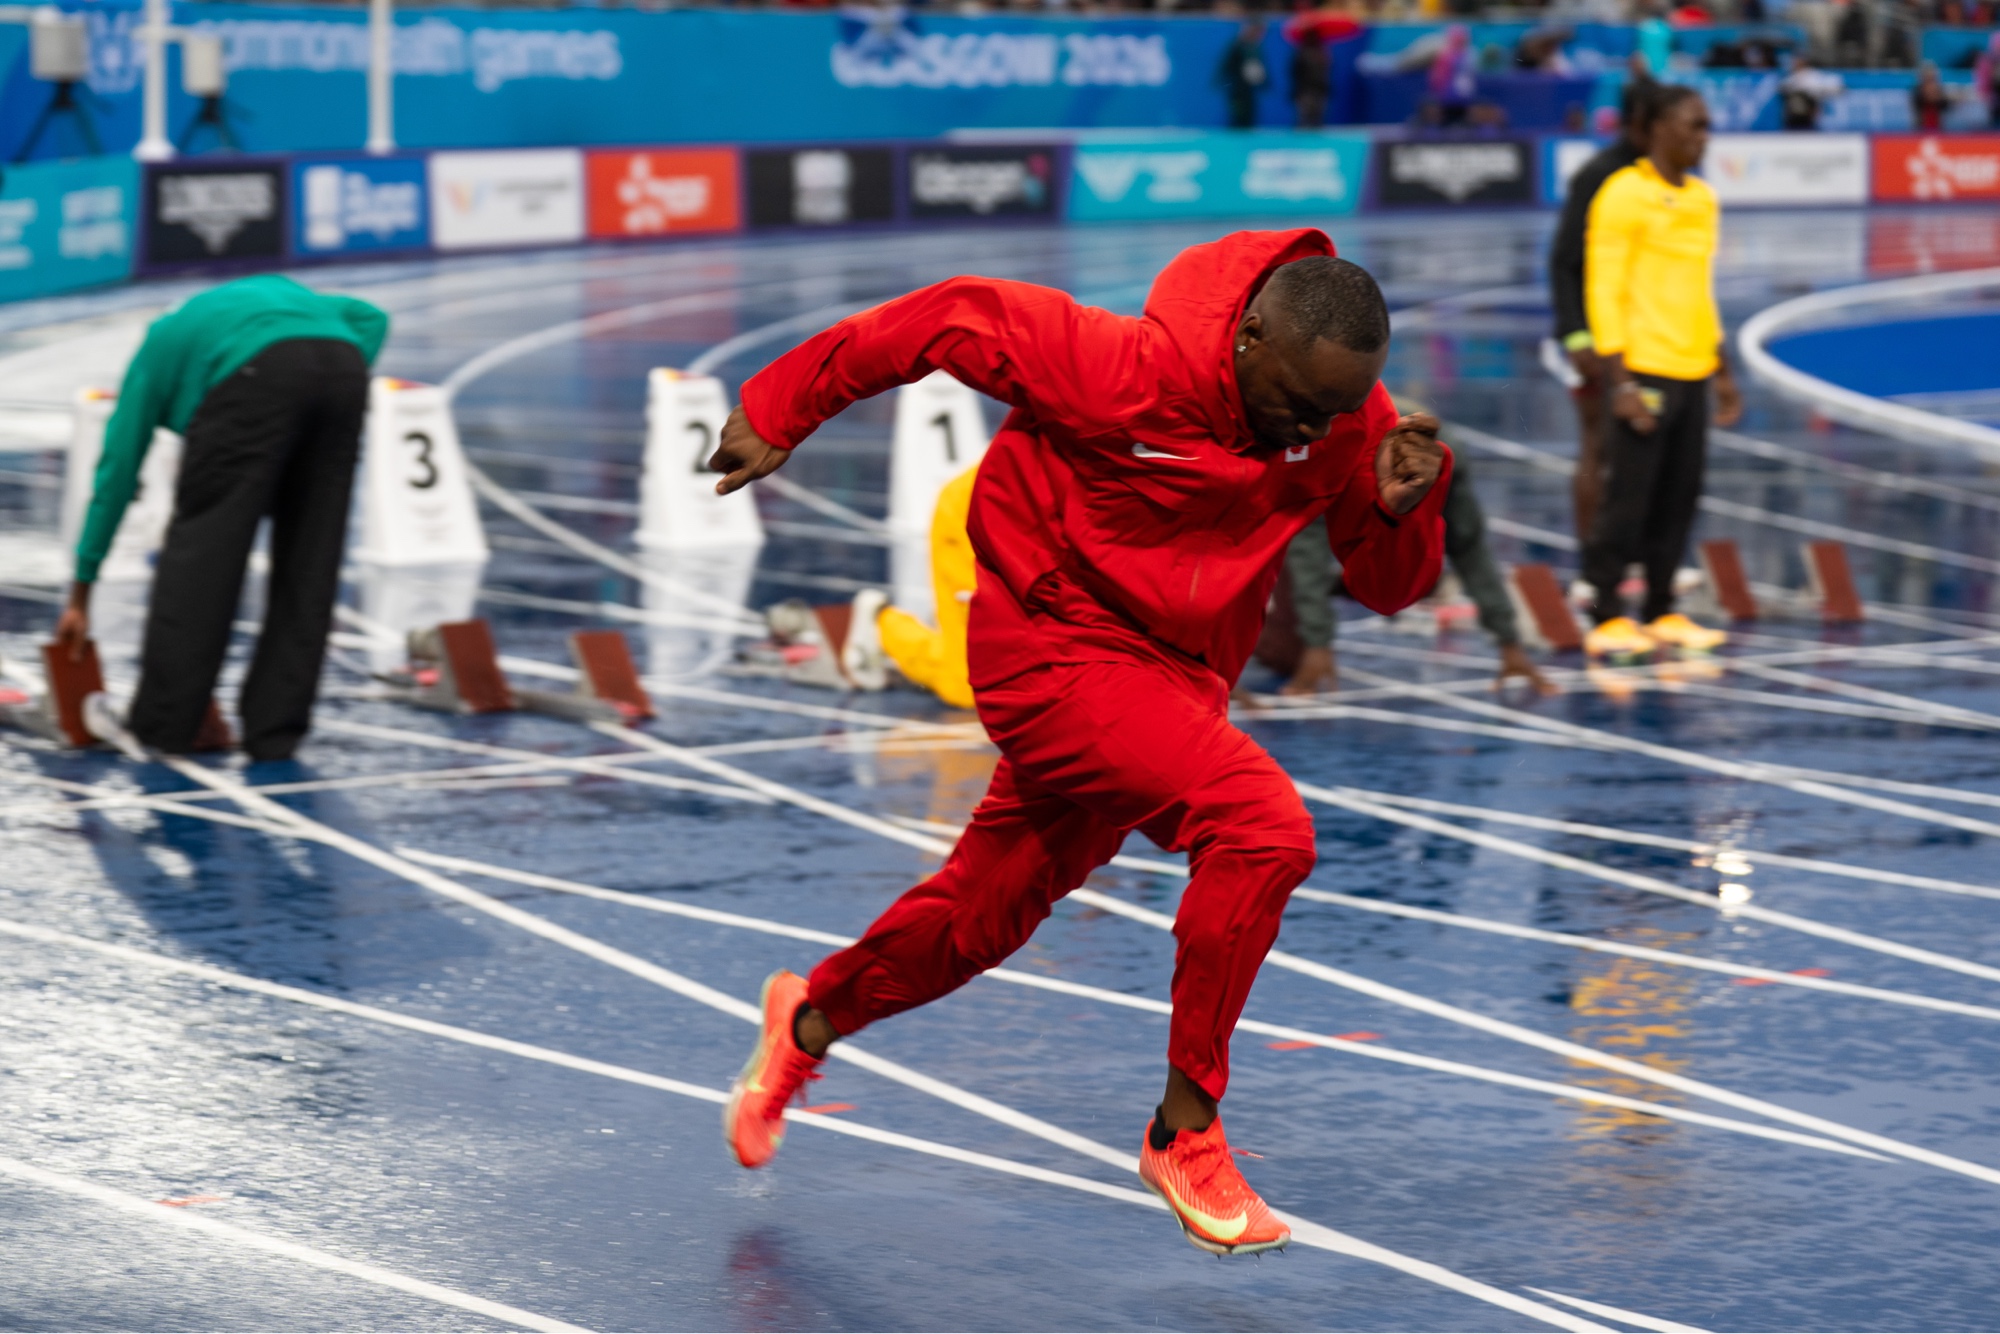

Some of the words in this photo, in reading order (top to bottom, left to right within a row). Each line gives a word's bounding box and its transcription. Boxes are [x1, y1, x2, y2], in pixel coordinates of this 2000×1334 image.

[1063, 34, 1170, 86] 2026
[402, 431, 439, 489] 3
[684, 421, 724, 474] 2
[928, 411, 957, 463] 1
